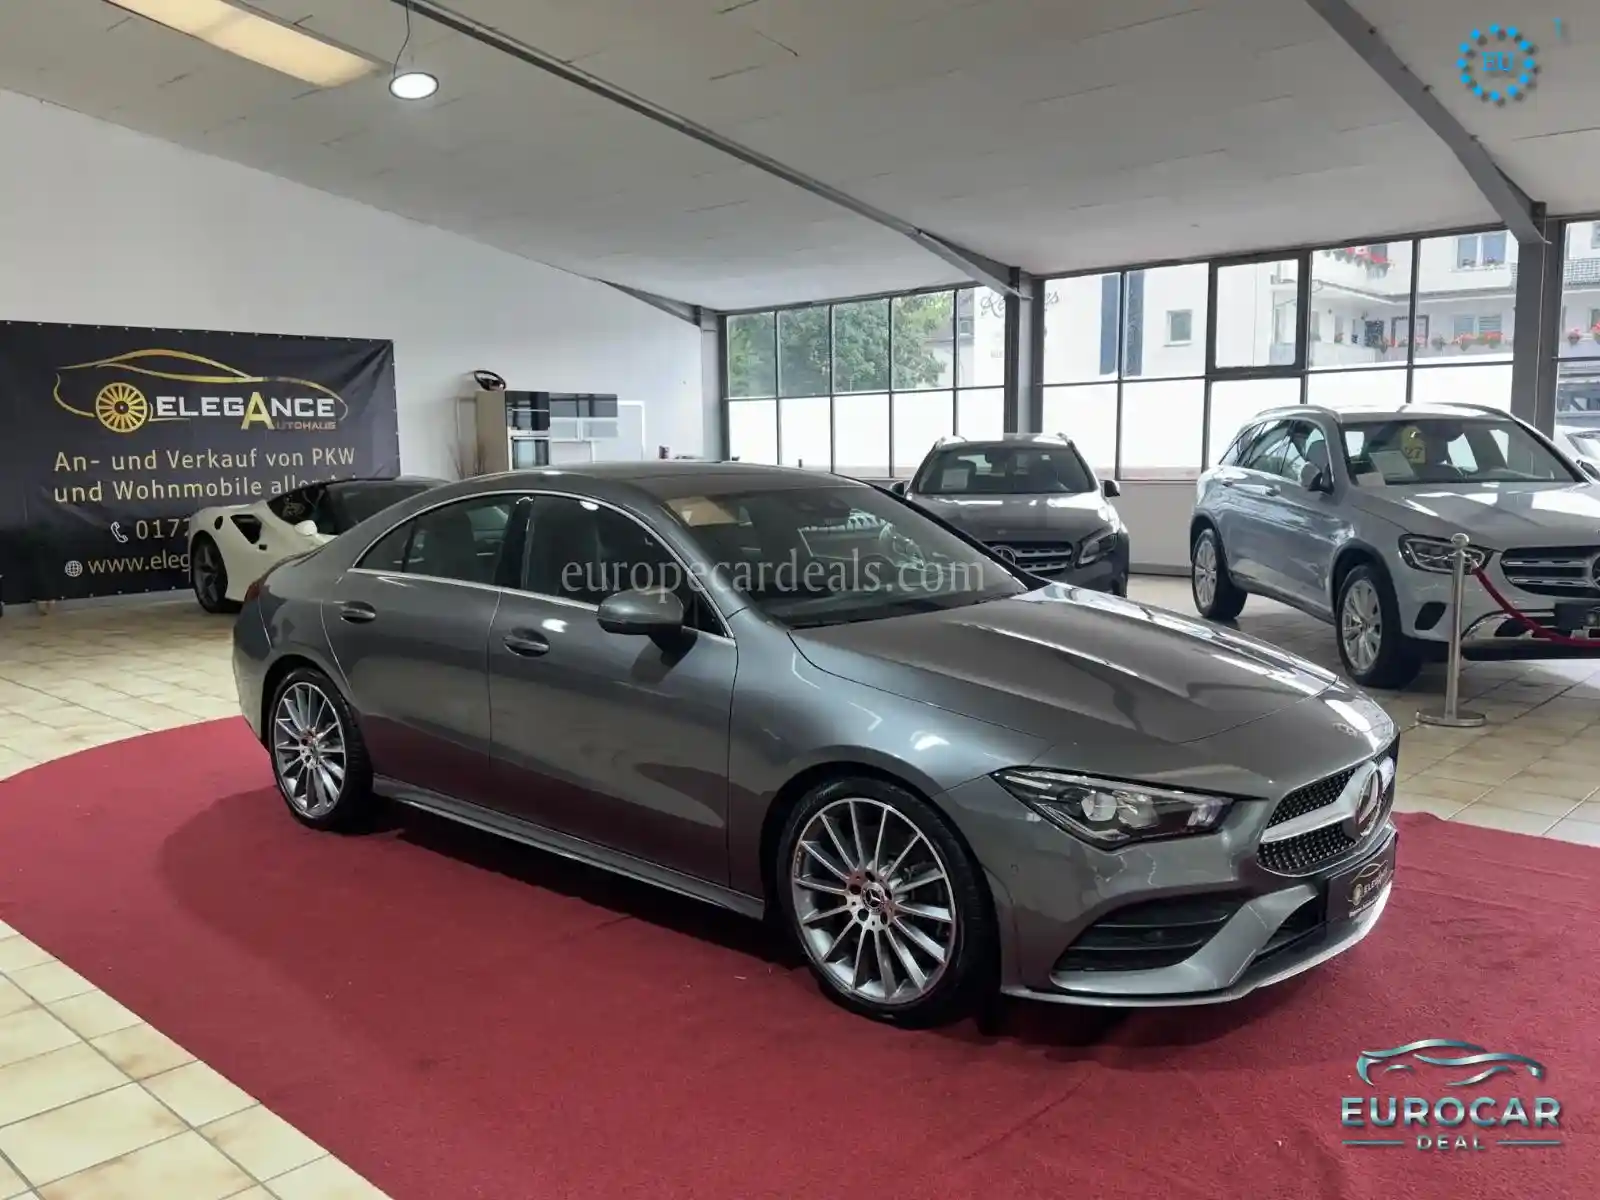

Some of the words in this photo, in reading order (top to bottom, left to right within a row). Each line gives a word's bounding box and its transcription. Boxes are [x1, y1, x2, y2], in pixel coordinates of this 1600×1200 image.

[155, 391, 336, 430] ELEGANCE
[54, 451, 100, 472] An-
[112, 450, 157, 471] und
[166, 448, 257, 470] Verkauf
[265, 452, 304, 468] von
[312, 447, 356, 466] PKW
[54, 480, 103, 503] und
[112, 476, 263, 500] Wohnmobile
[271, 474, 320, 494] all
